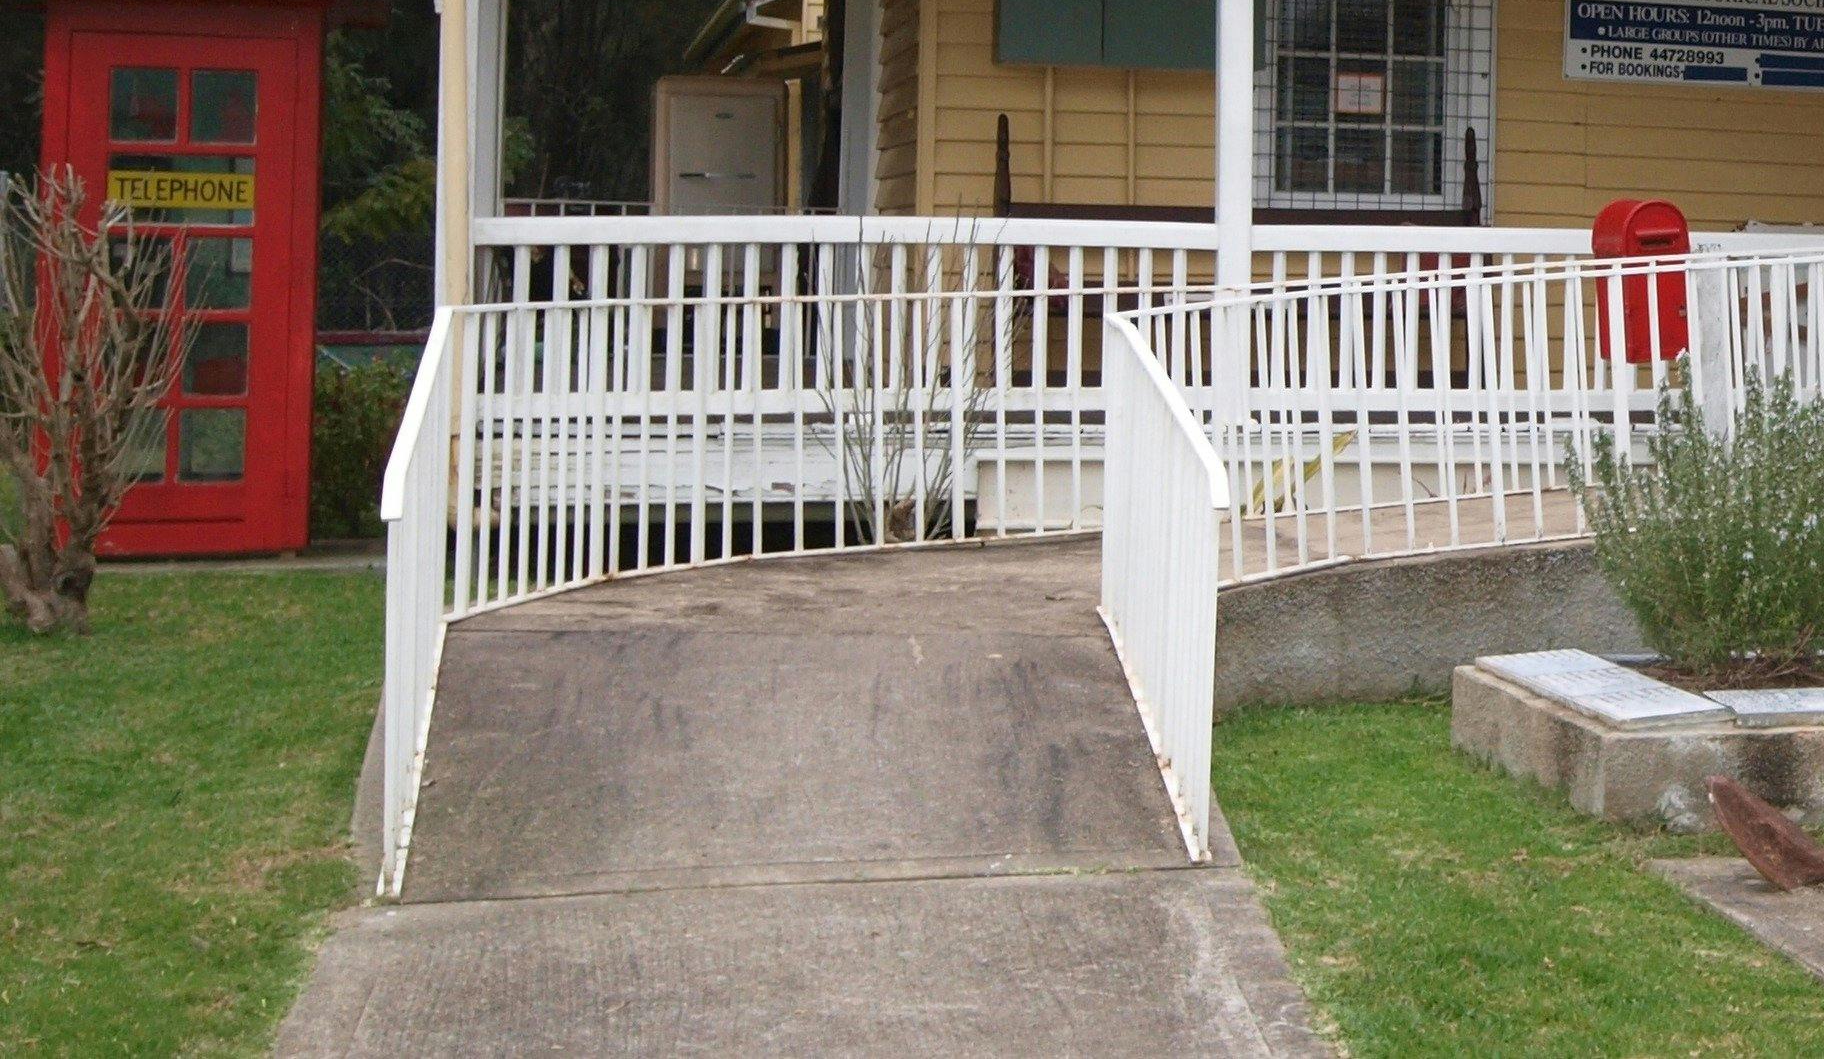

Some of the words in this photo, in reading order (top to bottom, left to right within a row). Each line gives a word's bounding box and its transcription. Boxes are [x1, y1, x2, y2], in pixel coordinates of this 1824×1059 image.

[1578, 2, 1624, 20] OPEN
[1696, 9, 1745, 27] 12noon
[1608, 25, 1650, 39] LARGE
[1794, 36, 1809, 49] BY
[1590, 44, 1643, 60] PHONE
[1649, 47, 1724, 65] 44728993
[1589, 61, 1614, 75] FOR
[114, 176, 249, 203] TELEPHONE
